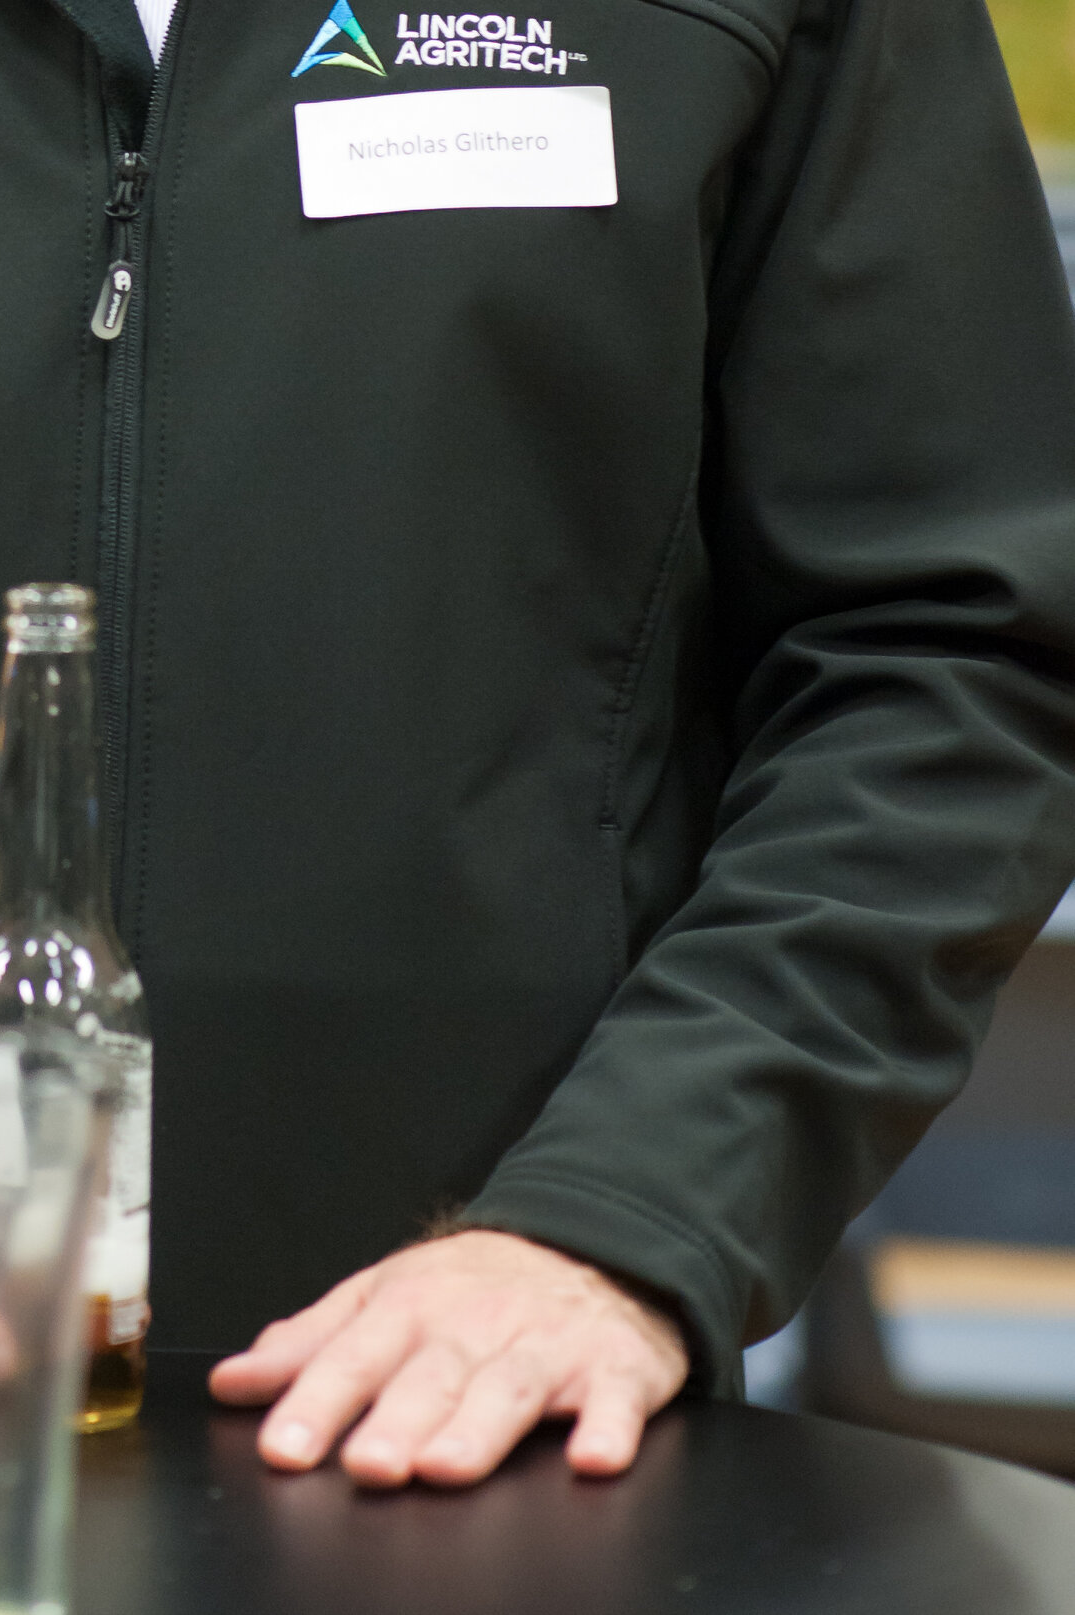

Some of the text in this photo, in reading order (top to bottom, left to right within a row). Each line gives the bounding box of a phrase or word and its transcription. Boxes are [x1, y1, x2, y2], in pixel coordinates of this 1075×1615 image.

[396, 13, 552, 44] LINCOLN
[394, 39, 568, 75] AGRITECH
[348, 131, 550, 161] Nicholas Glithero
